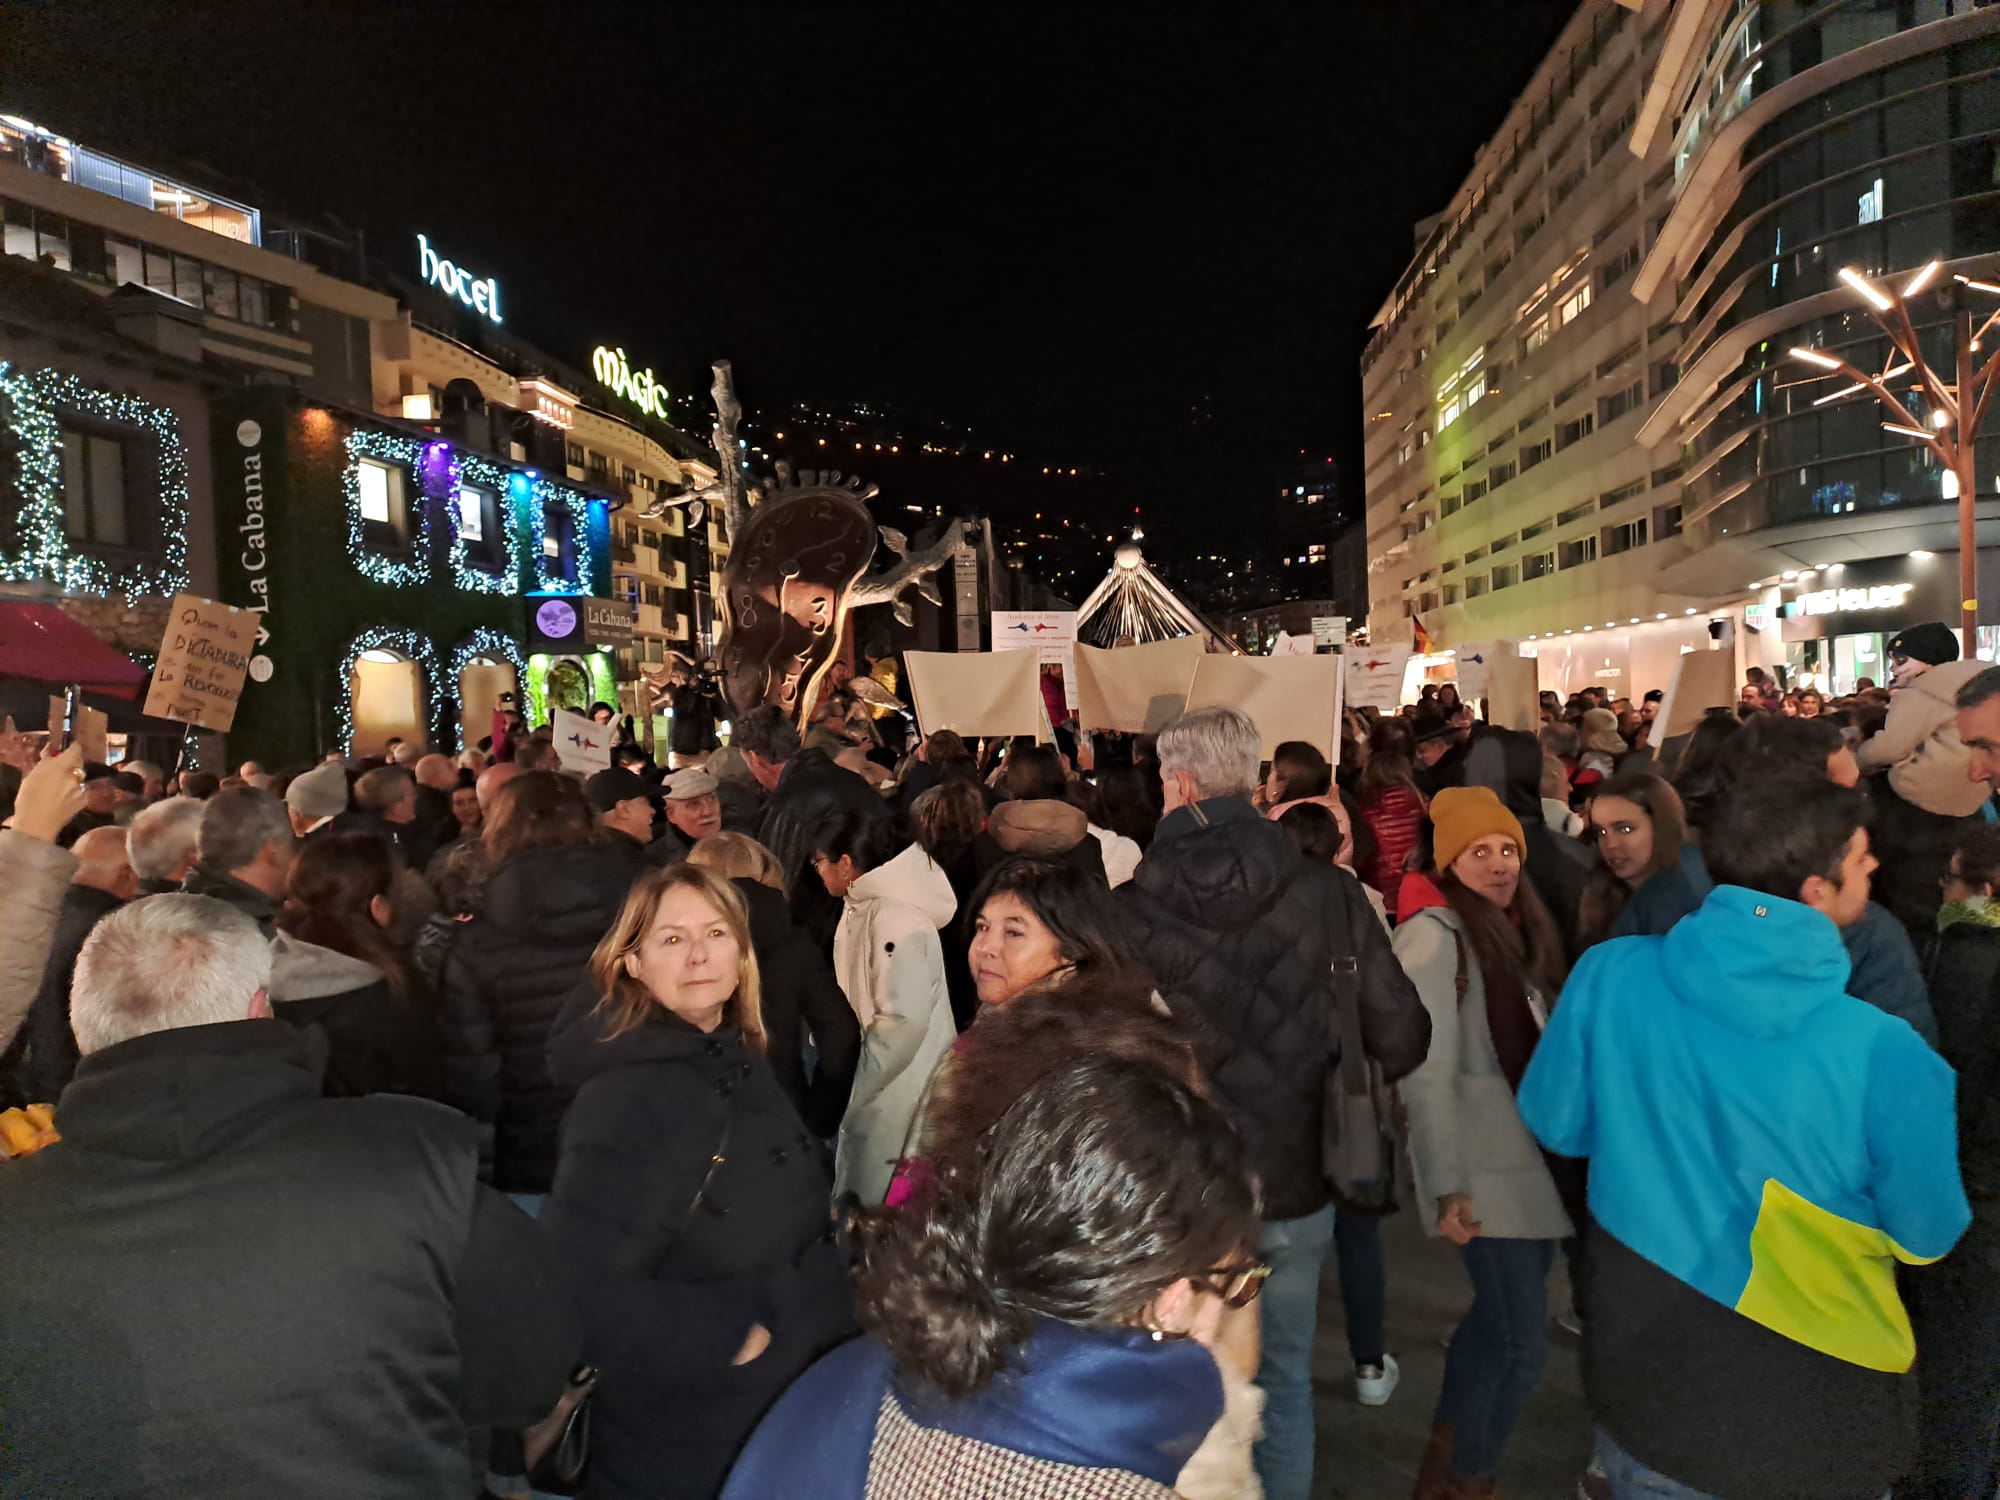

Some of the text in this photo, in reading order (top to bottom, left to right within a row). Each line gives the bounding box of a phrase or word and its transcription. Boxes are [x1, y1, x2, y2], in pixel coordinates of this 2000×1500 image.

[239, 452, 270, 614] La Cabana
[588, 606, 632, 628] La Cabana
